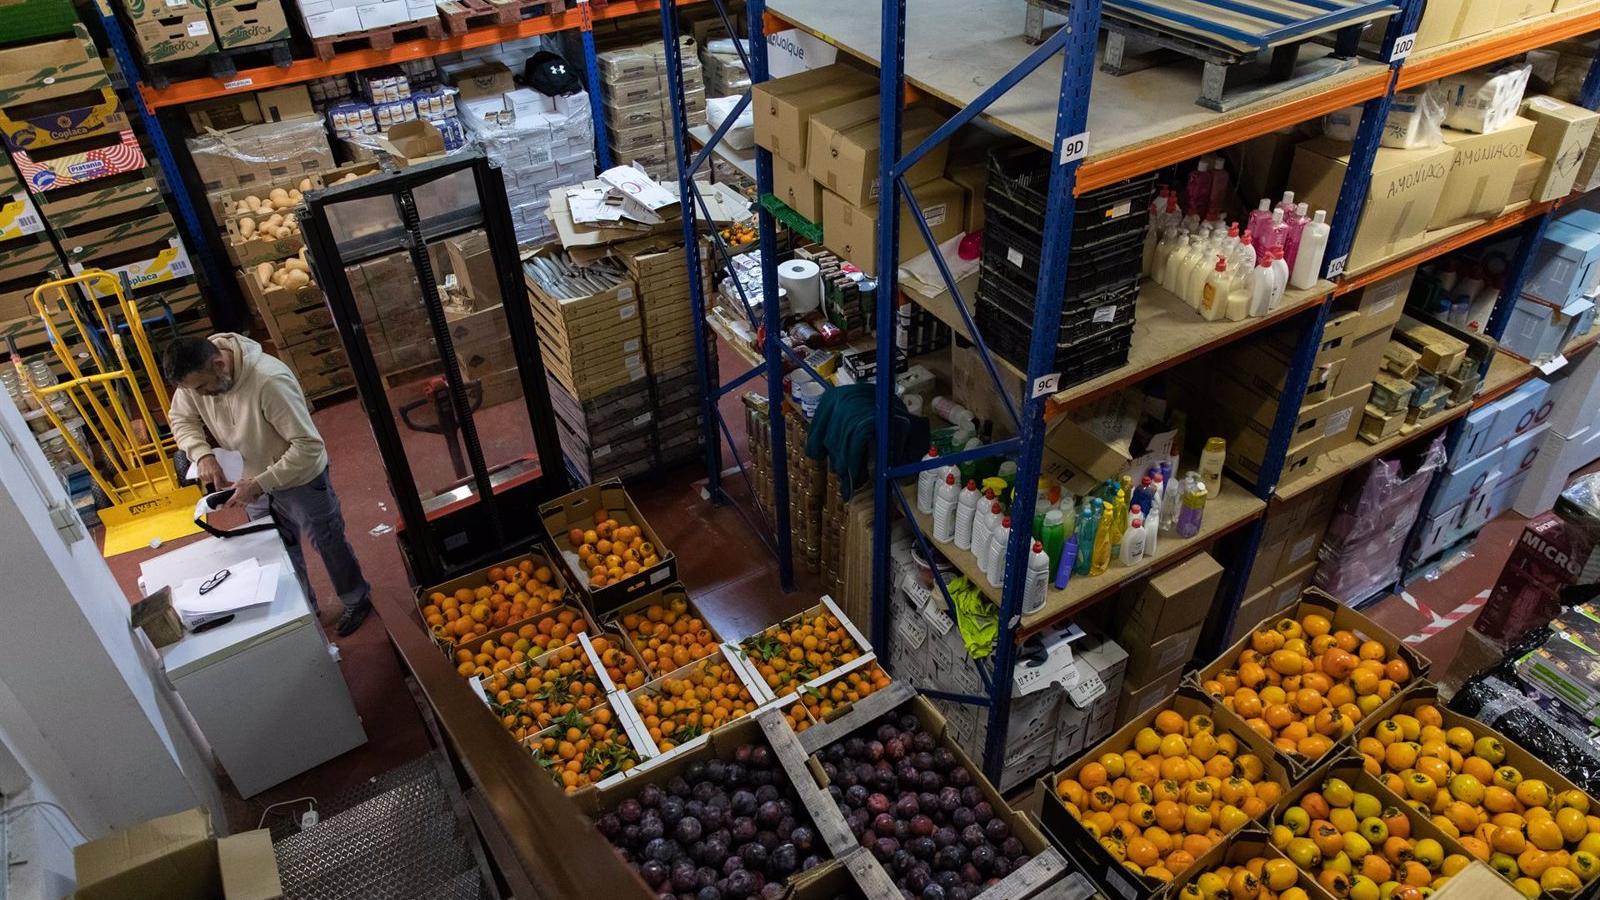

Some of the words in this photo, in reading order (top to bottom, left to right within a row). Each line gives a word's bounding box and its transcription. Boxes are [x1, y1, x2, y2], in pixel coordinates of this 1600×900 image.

[1394, 39, 1413, 55] 10D
[51, 126, 88, 140] Coplaca
[1066, 140, 1083, 156] 9D
[1038, 378, 1053, 391] 9C
[1522, 530, 1581, 576] MICRO
